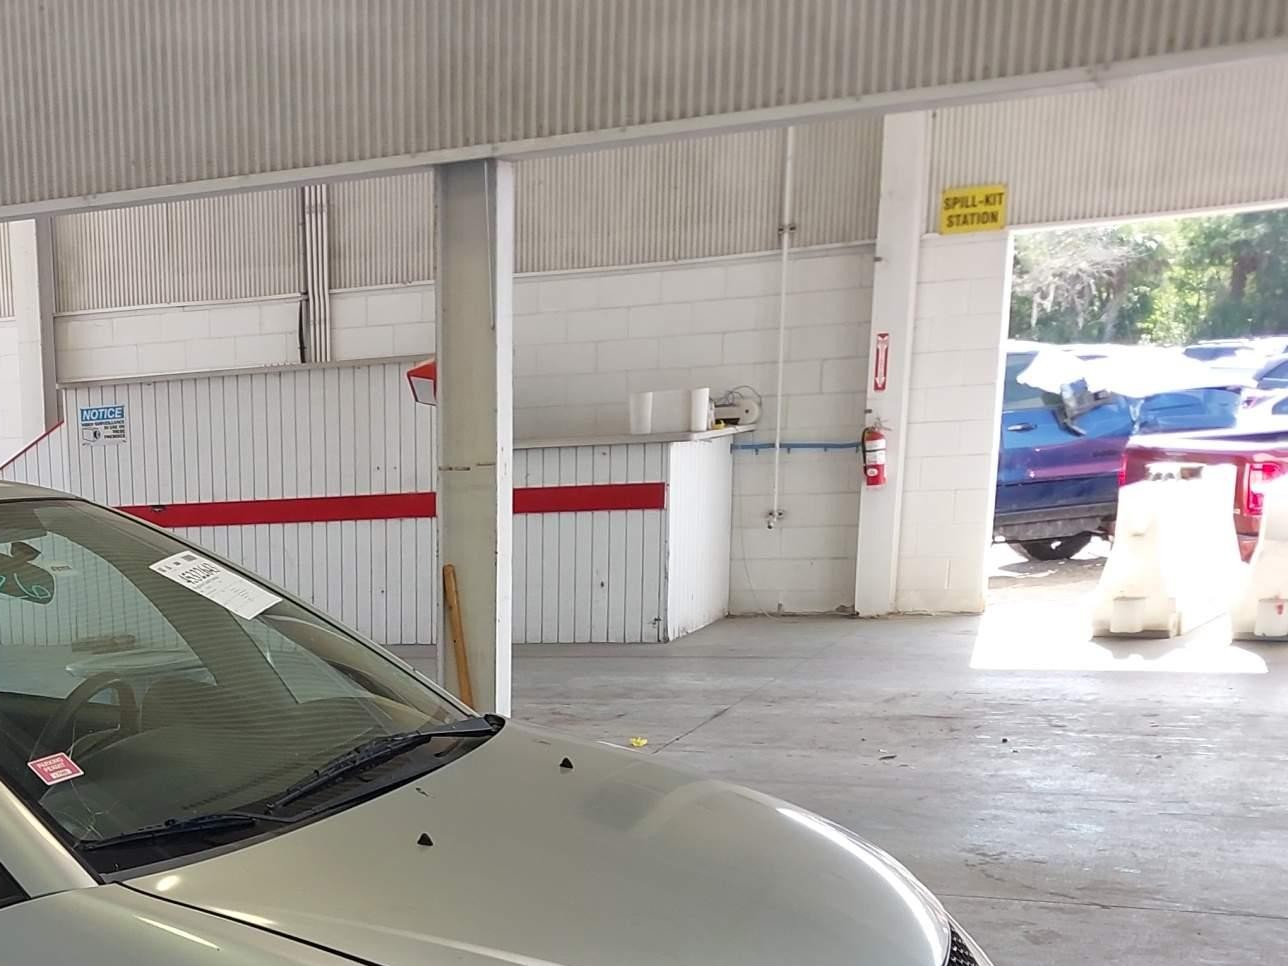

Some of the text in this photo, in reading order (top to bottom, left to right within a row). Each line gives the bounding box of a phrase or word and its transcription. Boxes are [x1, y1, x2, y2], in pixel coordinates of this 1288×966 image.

[944, 193, 1004, 210] SPILL-KIT
[946, 211, 999, 228] STATION
[82, 407, 123, 420] NOTICE
